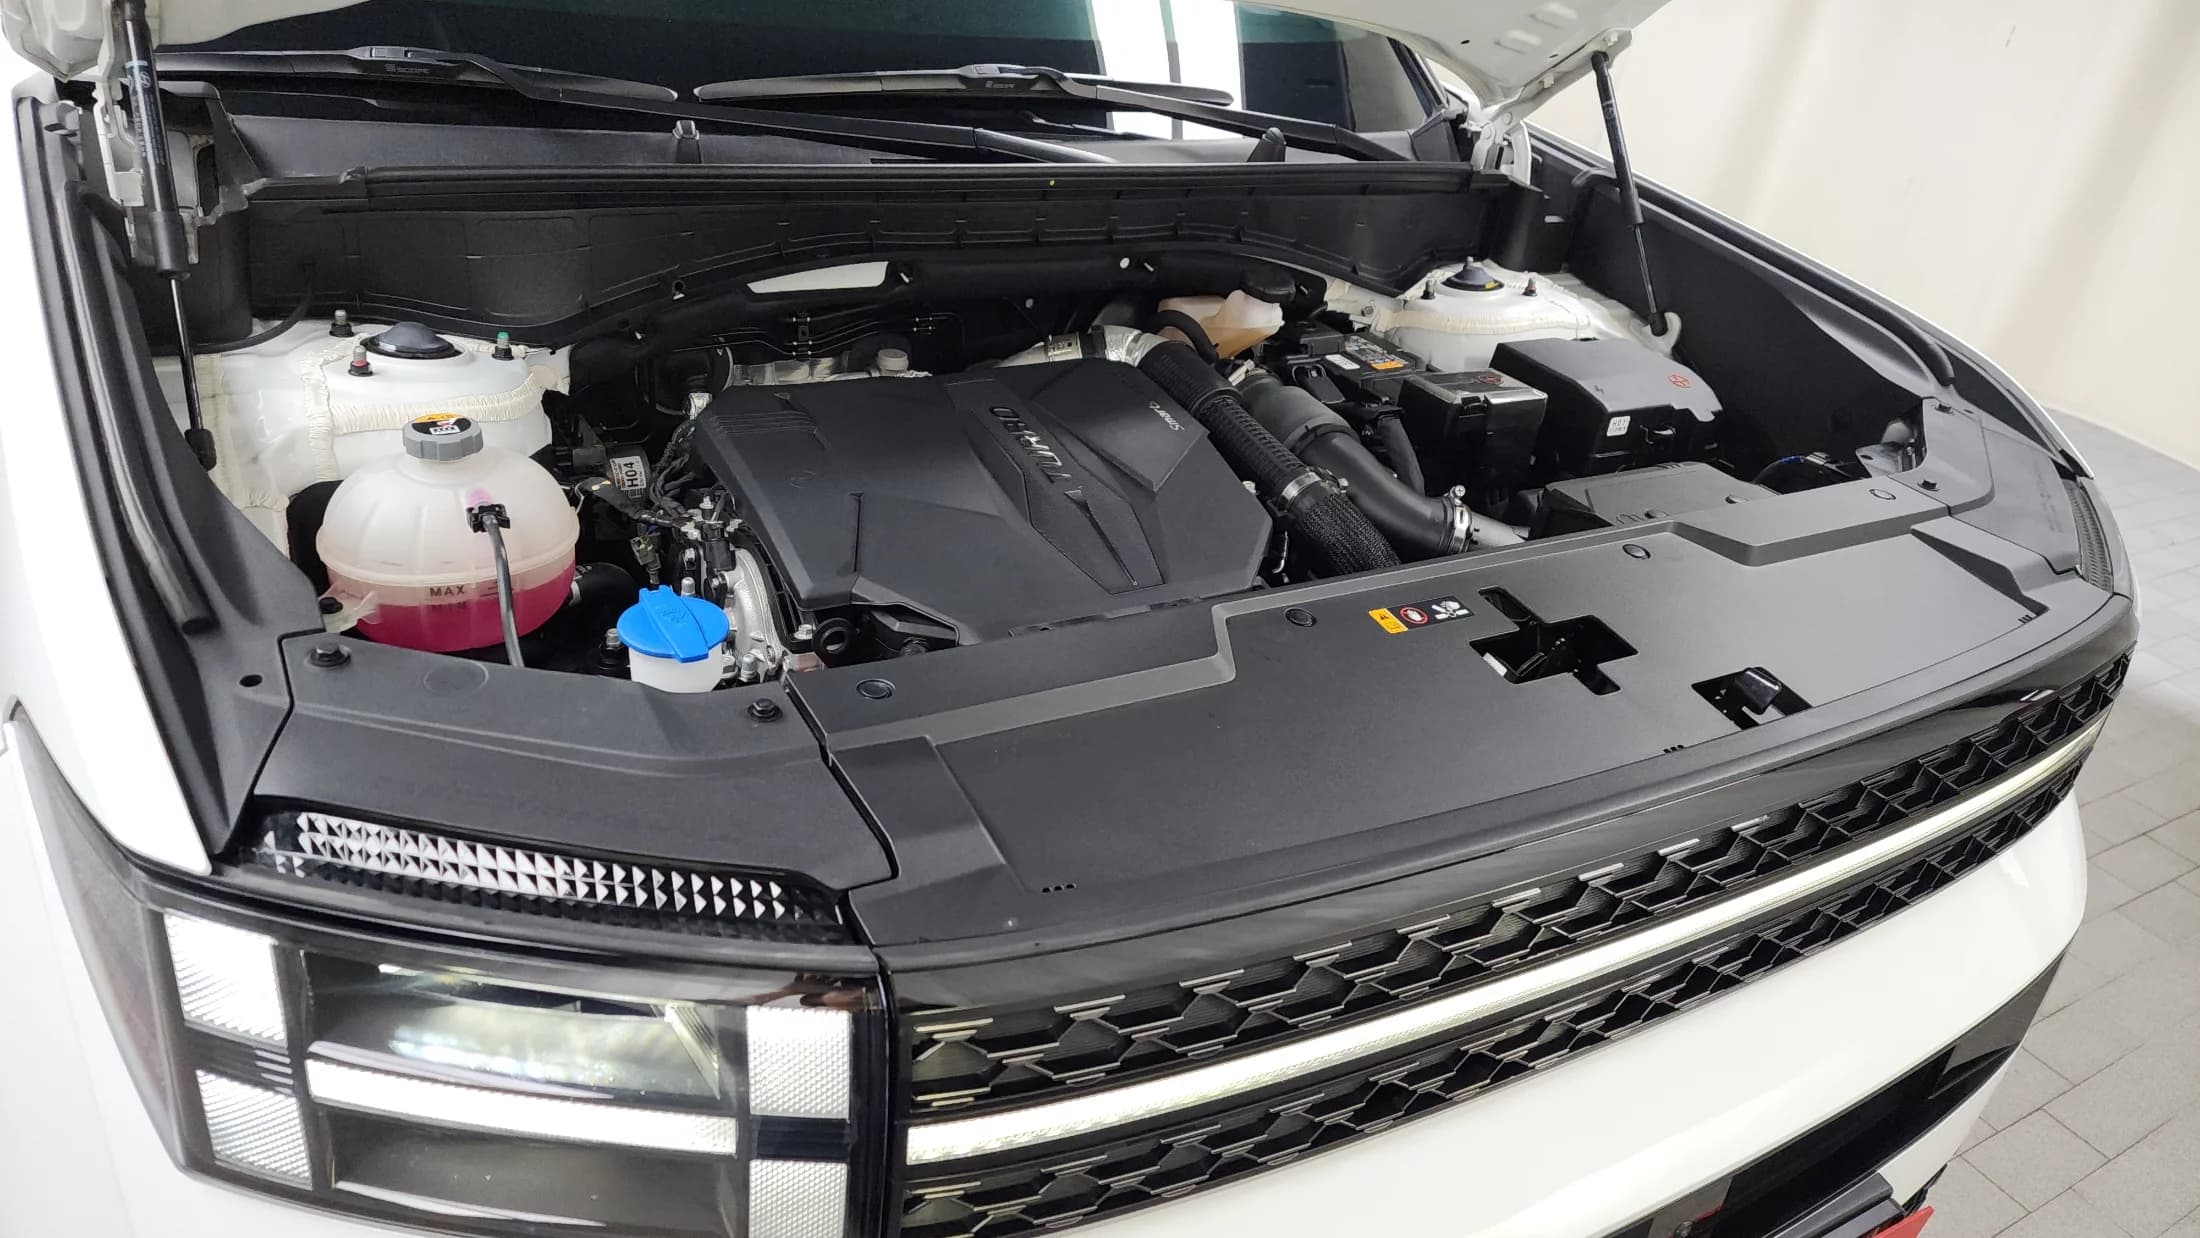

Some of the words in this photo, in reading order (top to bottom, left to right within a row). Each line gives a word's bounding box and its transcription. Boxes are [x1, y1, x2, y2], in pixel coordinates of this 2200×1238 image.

[989, 406, 1072, 484] TURBO
[623, 461, 639, 487] H04
[429, 585, 465, 597] MAX
